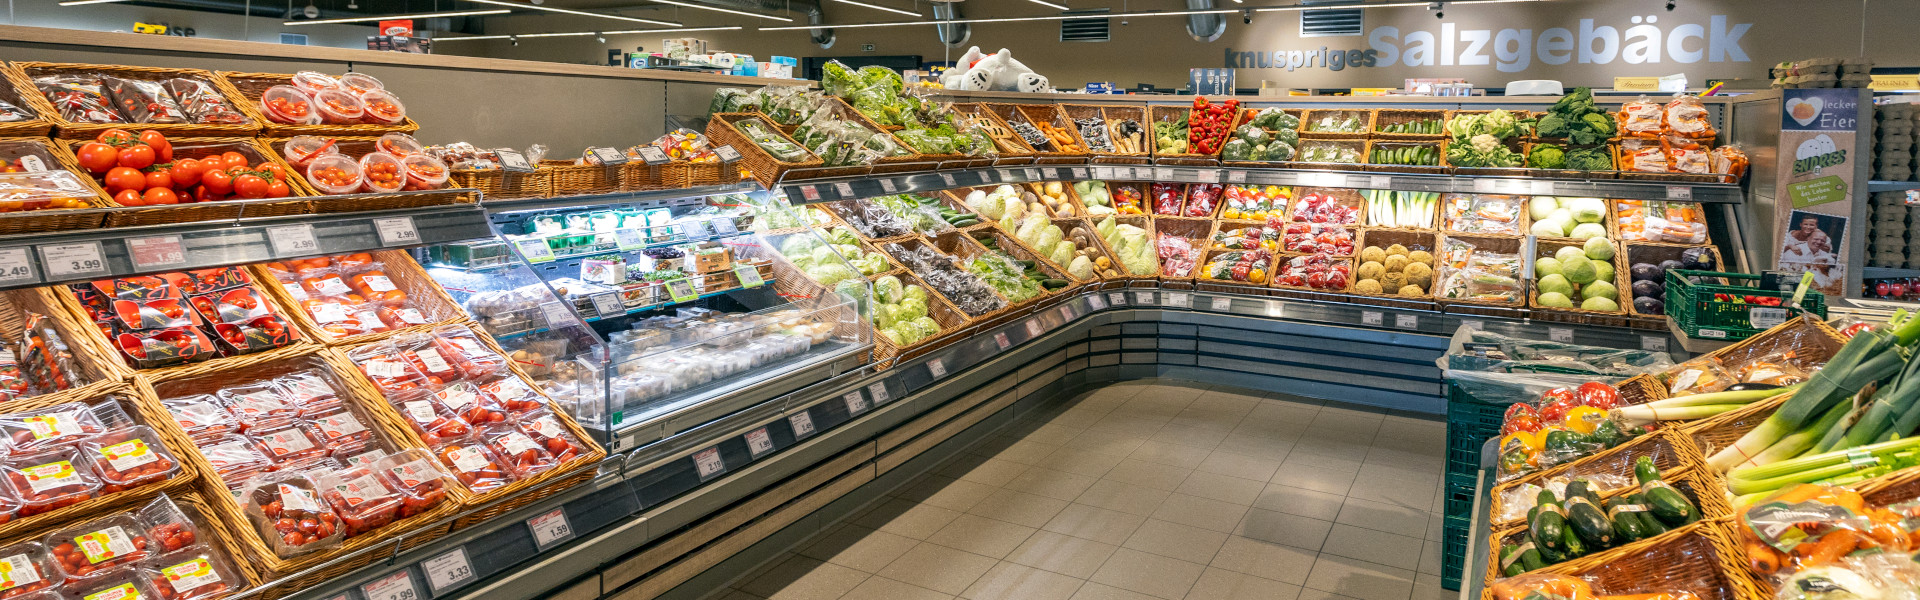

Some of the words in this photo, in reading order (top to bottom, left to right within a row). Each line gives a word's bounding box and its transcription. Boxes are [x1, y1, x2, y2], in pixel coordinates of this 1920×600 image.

[1225, 46, 1379, 72] knuspriges
[1368, 14, 1754, 73] Salzgebäck
[1824, 100, 1857, 109] lecker
[1820, 112, 1856, 128] Eier
[1792, 149, 1847, 175] ENDRES
[396, 230, 415, 239] 2.99
[293, 239, 315, 249] 2.99
[156, 251, 183, 262] 1.99
[72, 259, 101, 270] 3.99
[550, 524, 568, 537] 1.59
[447, 565, 470, 580] 3.33
